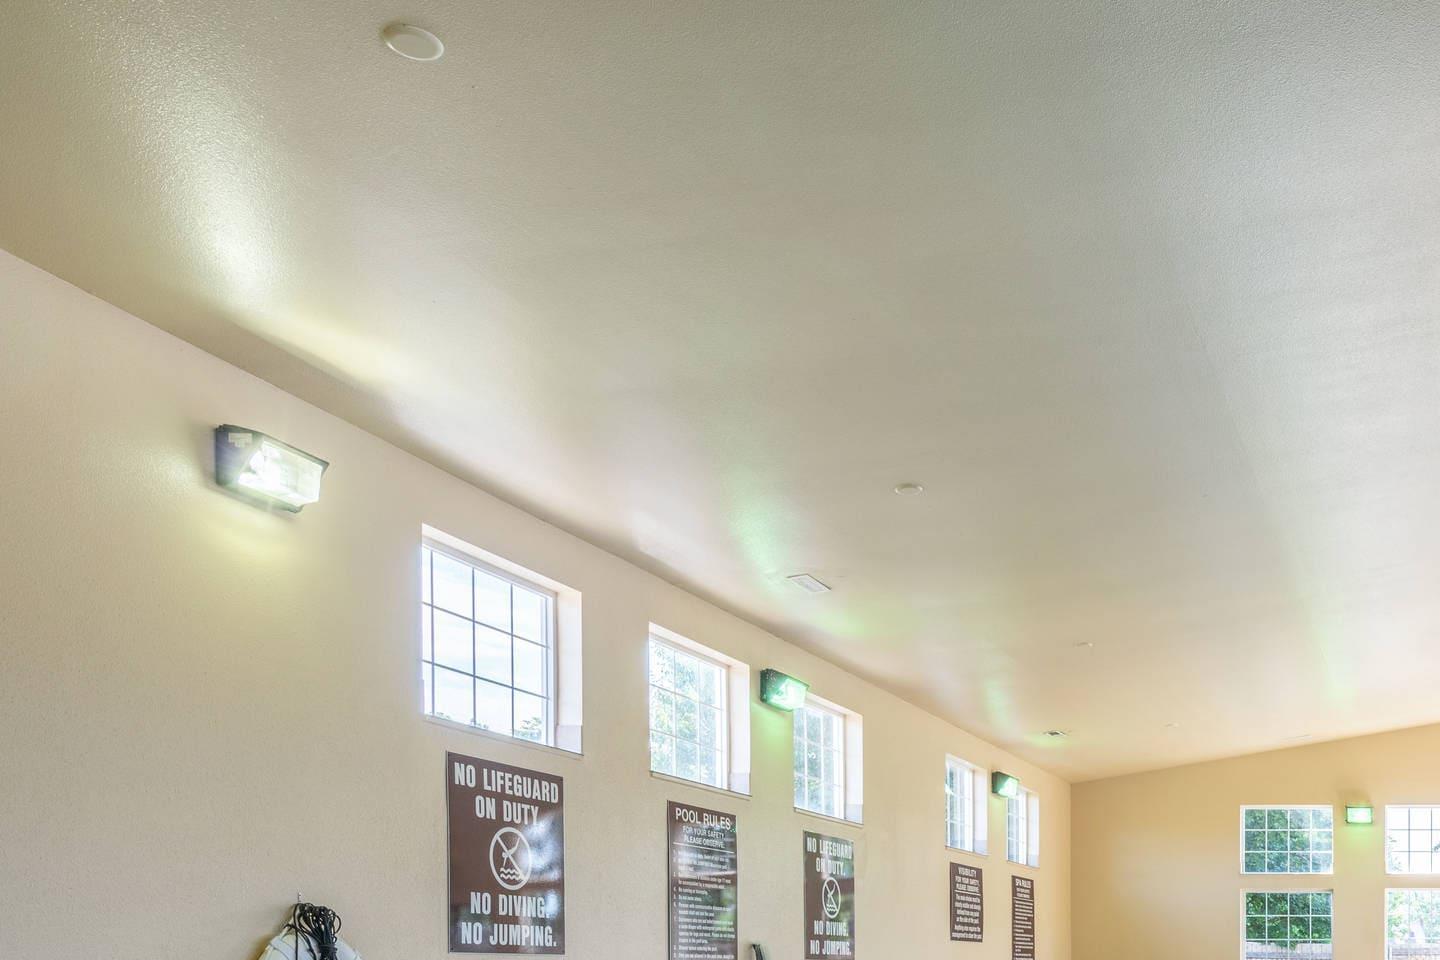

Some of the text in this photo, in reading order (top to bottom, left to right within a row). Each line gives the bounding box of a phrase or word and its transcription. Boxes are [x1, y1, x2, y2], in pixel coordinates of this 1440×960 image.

[454, 762, 559, 804] NO LIFEGUARD
[475, 795, 496, 820] ON
[675, 807, 731, 830] POOL RULES
[682, 825, 693, 834] FOR
[694, 827, 706, 836] YOUR
[684, 834, 702, 845] PLEASE
[807, 837, 852, 860] NO LIFEGUARD
[816, 858, 825, 873] ON
[470, 891, 491, 915] NO
[461, 922, 557, 947] NO JUMPING.
[814, 920, 849, 937] NO DIVING.
[810, 940, 852, 956] NO JUMPING.
